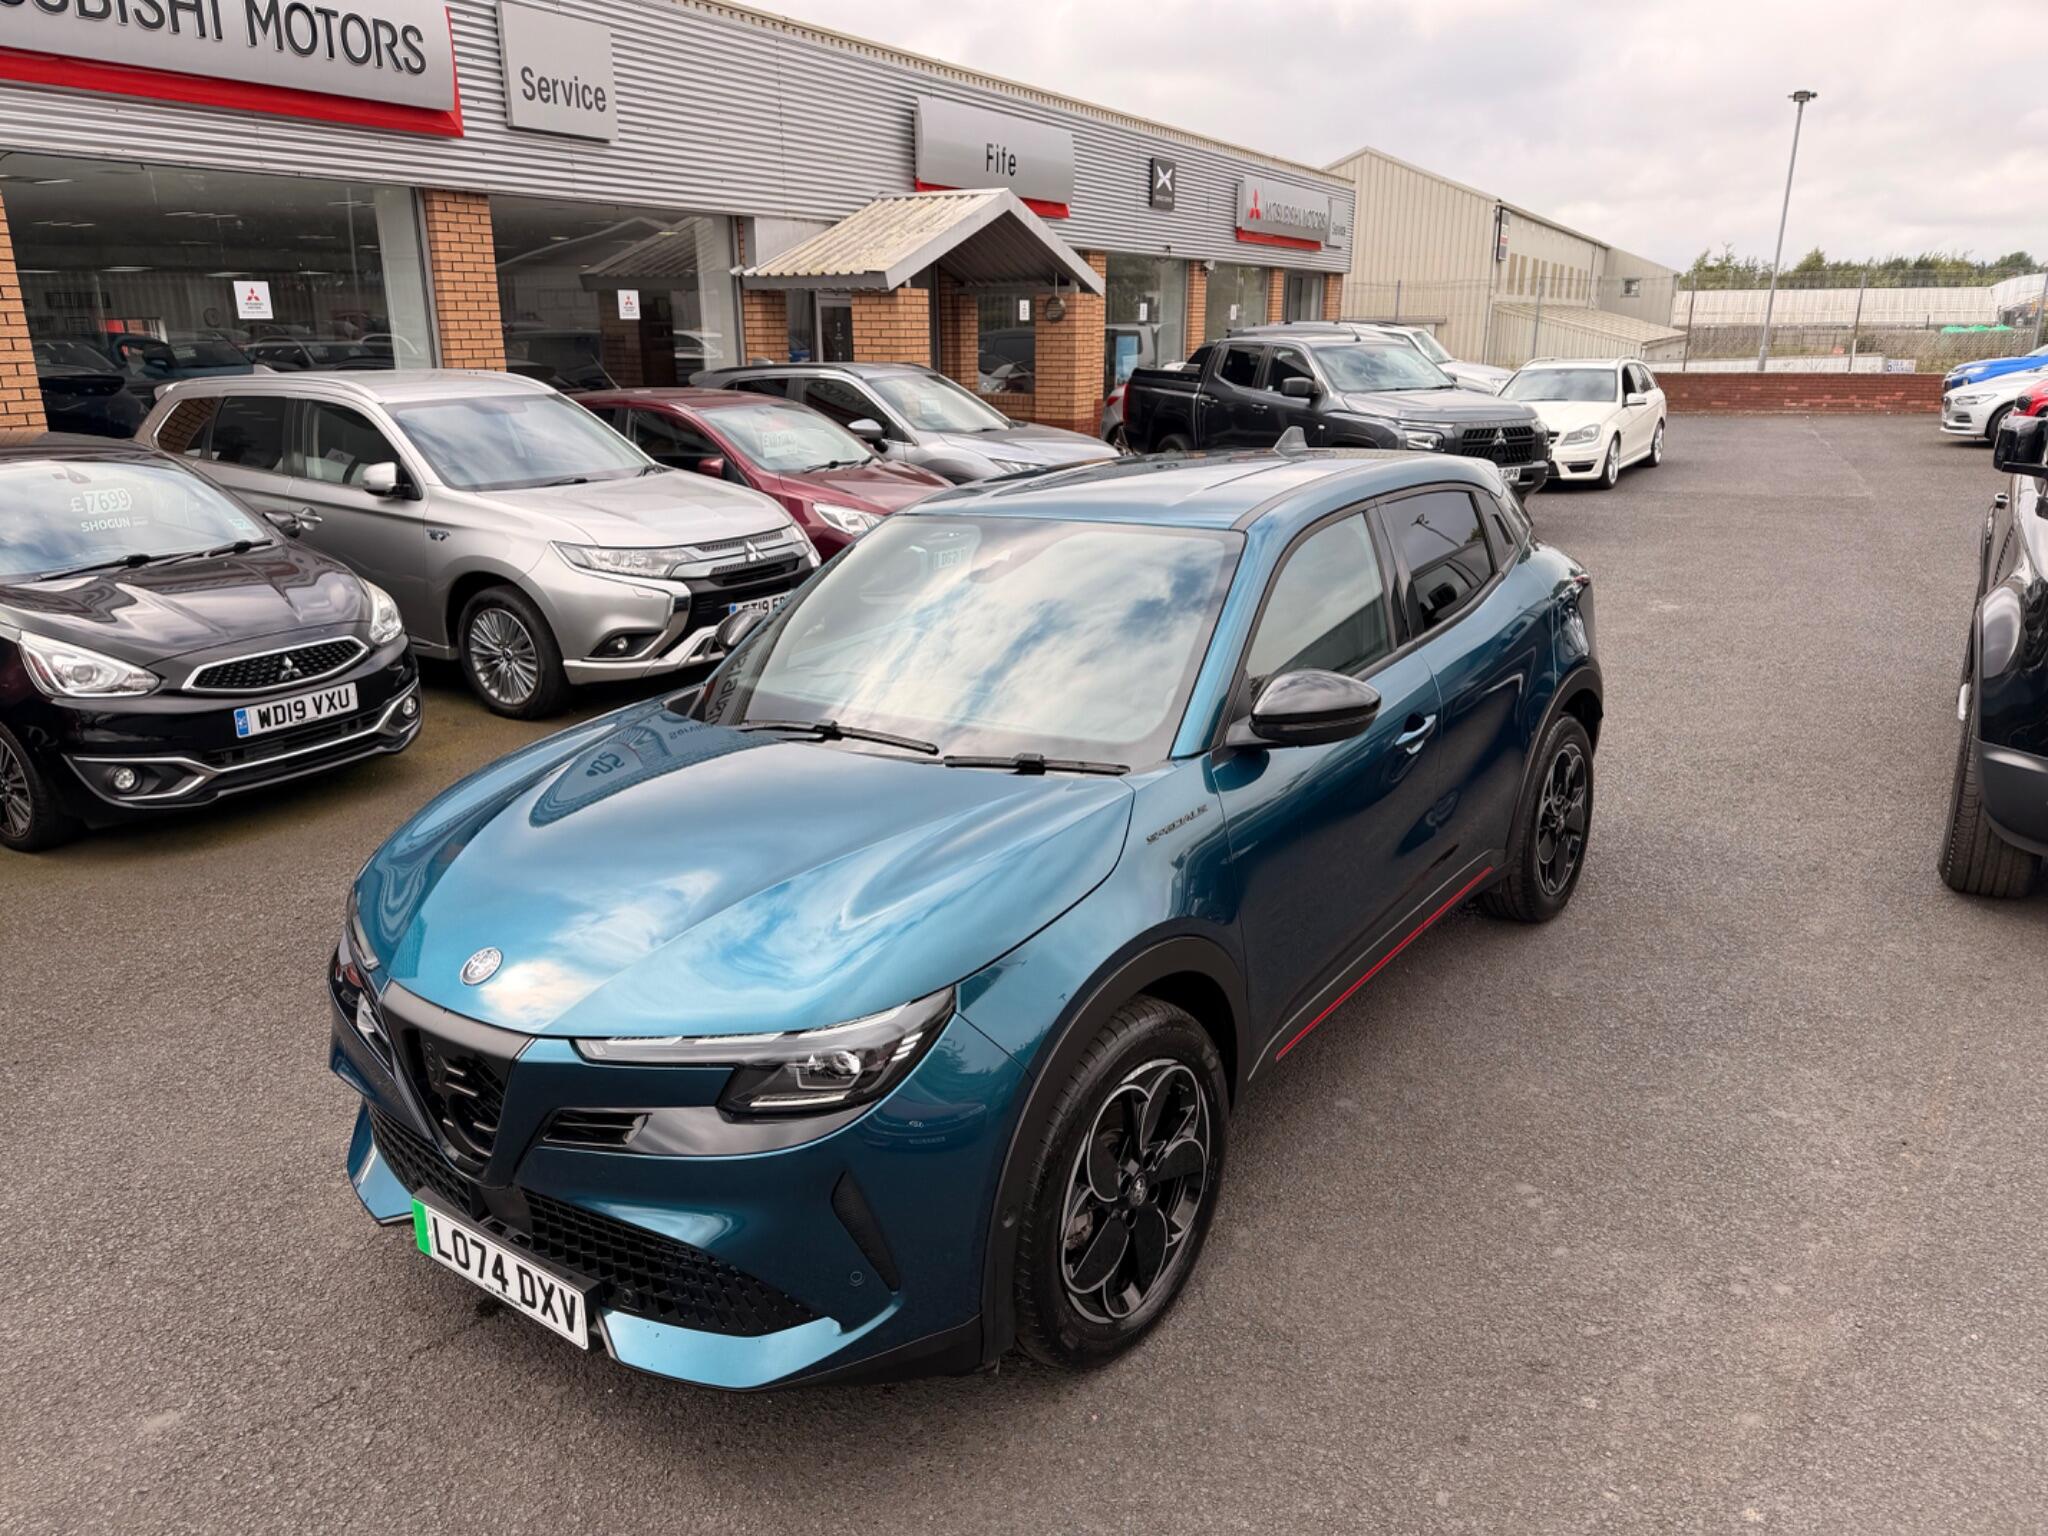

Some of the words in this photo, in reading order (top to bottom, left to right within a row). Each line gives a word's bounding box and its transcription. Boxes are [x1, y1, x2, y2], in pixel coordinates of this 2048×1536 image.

[245, 0, 427, 75] MOTORS
[521, 66, 607, 112] Service
[986, 143, 1016, 176] Fife
[81, 517, 131, 533] SHOGUN
[257, 700, 306, 729] WD19
[312, 688, 350, 715] VXU
[516, 1264, 576, 1333] DXV
